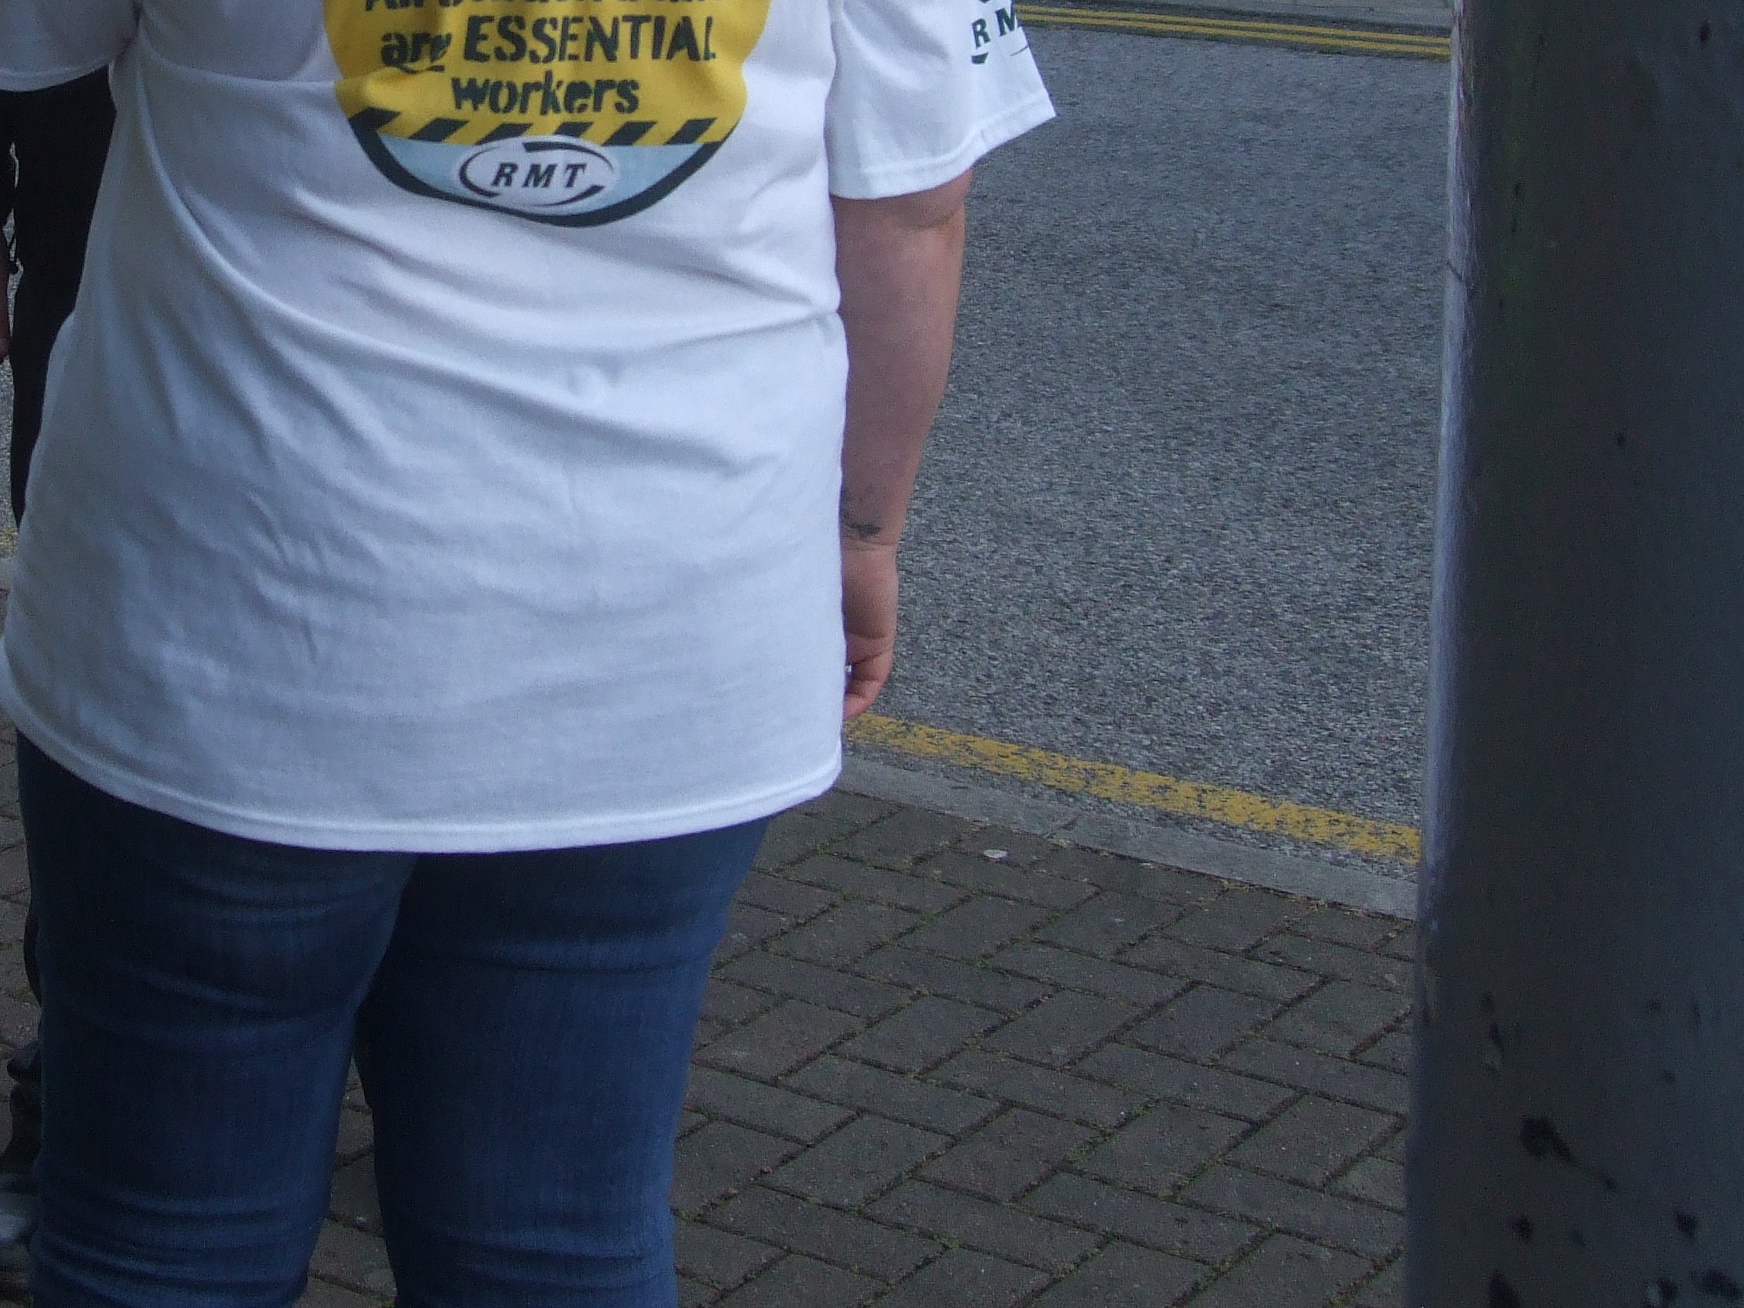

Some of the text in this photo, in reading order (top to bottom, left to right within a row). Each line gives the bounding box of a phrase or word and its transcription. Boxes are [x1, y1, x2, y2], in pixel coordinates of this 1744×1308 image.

[380, 14, 717, 71] are ESSENTIAL
[451, 69, 640, 115] workers
[490, 162, 590, 190] RMT
